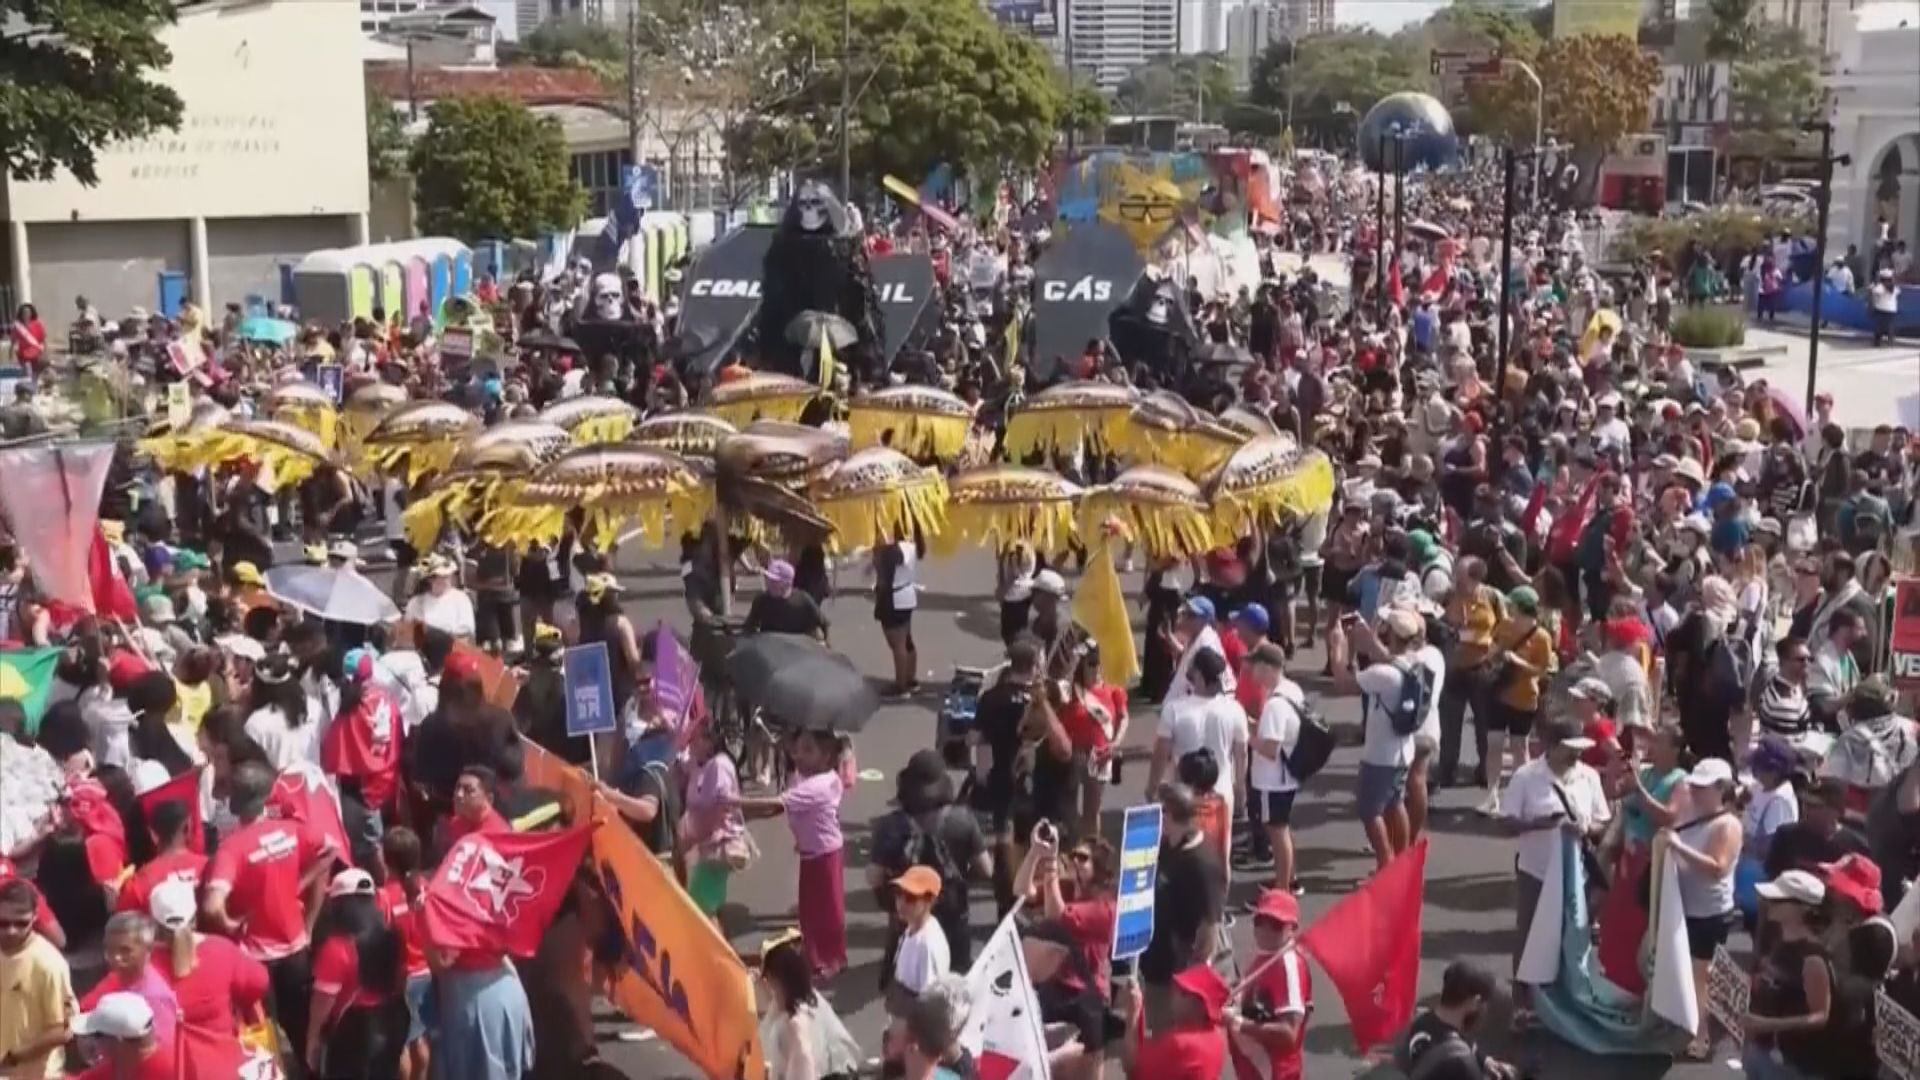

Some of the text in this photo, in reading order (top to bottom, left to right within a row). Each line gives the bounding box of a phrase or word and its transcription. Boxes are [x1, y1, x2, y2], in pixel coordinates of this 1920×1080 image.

[691, 279, 762, 298] COAL
[880, 282, 914, 303] IL
[1044, 275, 1112, 301] GÁS
